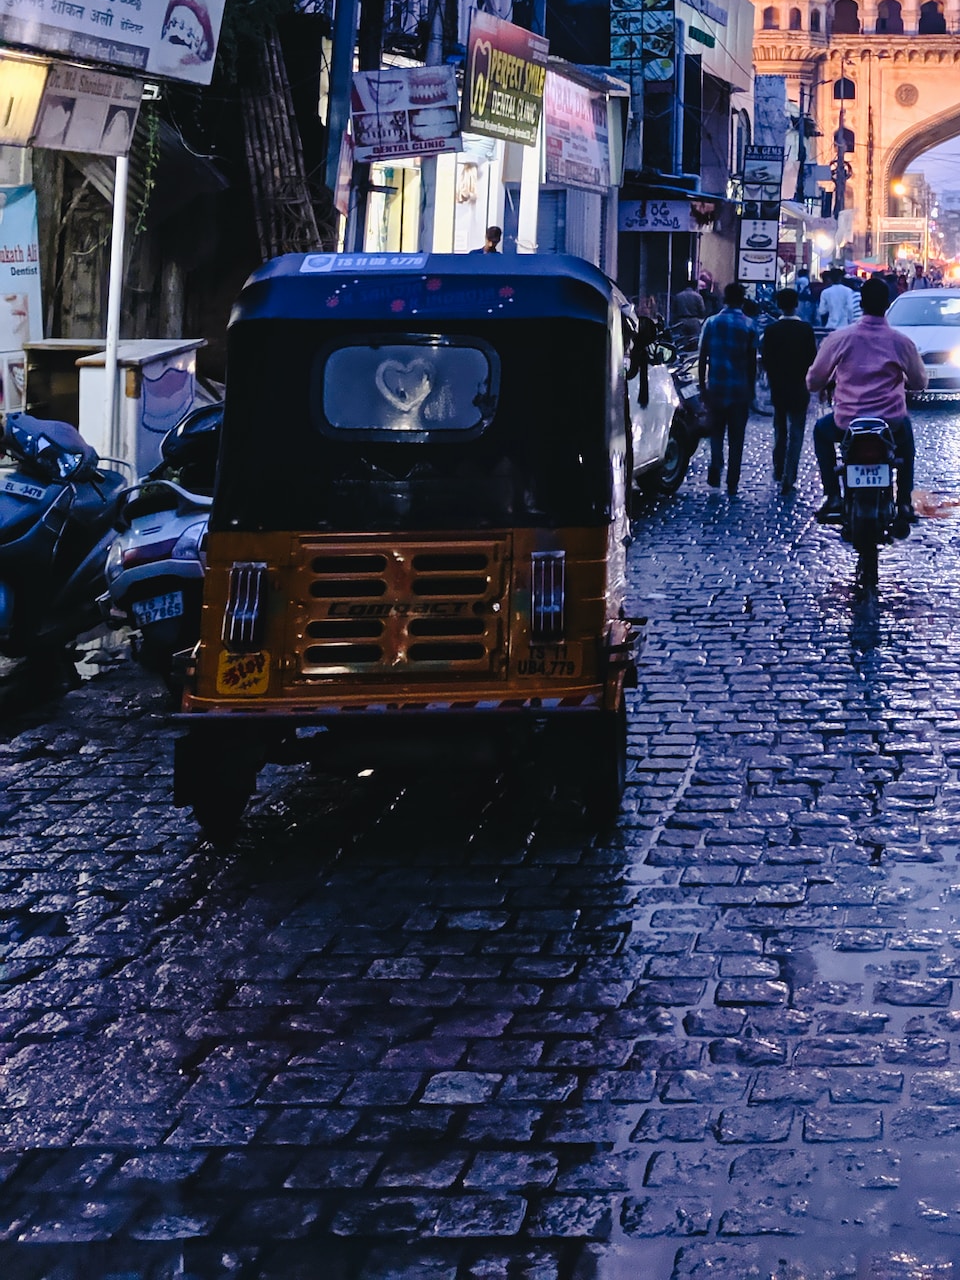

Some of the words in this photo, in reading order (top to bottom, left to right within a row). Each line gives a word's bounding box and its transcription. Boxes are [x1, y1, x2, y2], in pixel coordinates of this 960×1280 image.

[90, 8, 115, 27] अली
[491, 48, 525, 90] PERFECT
[523, 61, 547, 98] SMILE
[491, 90, 516, 120] DENTAL
[516, 98, 538, 125] CLINIC
[373, 143, 410, 154] DENTAL
[412, 140, 446, 150] CLINIC
[762, 147, 782, 155] GEMS
[337, 257, 353, 266] TS
[11, 266, 38, 276] Dentist
[528, 645, 545, 659] TS
[554, 645, 568, 659] 11
